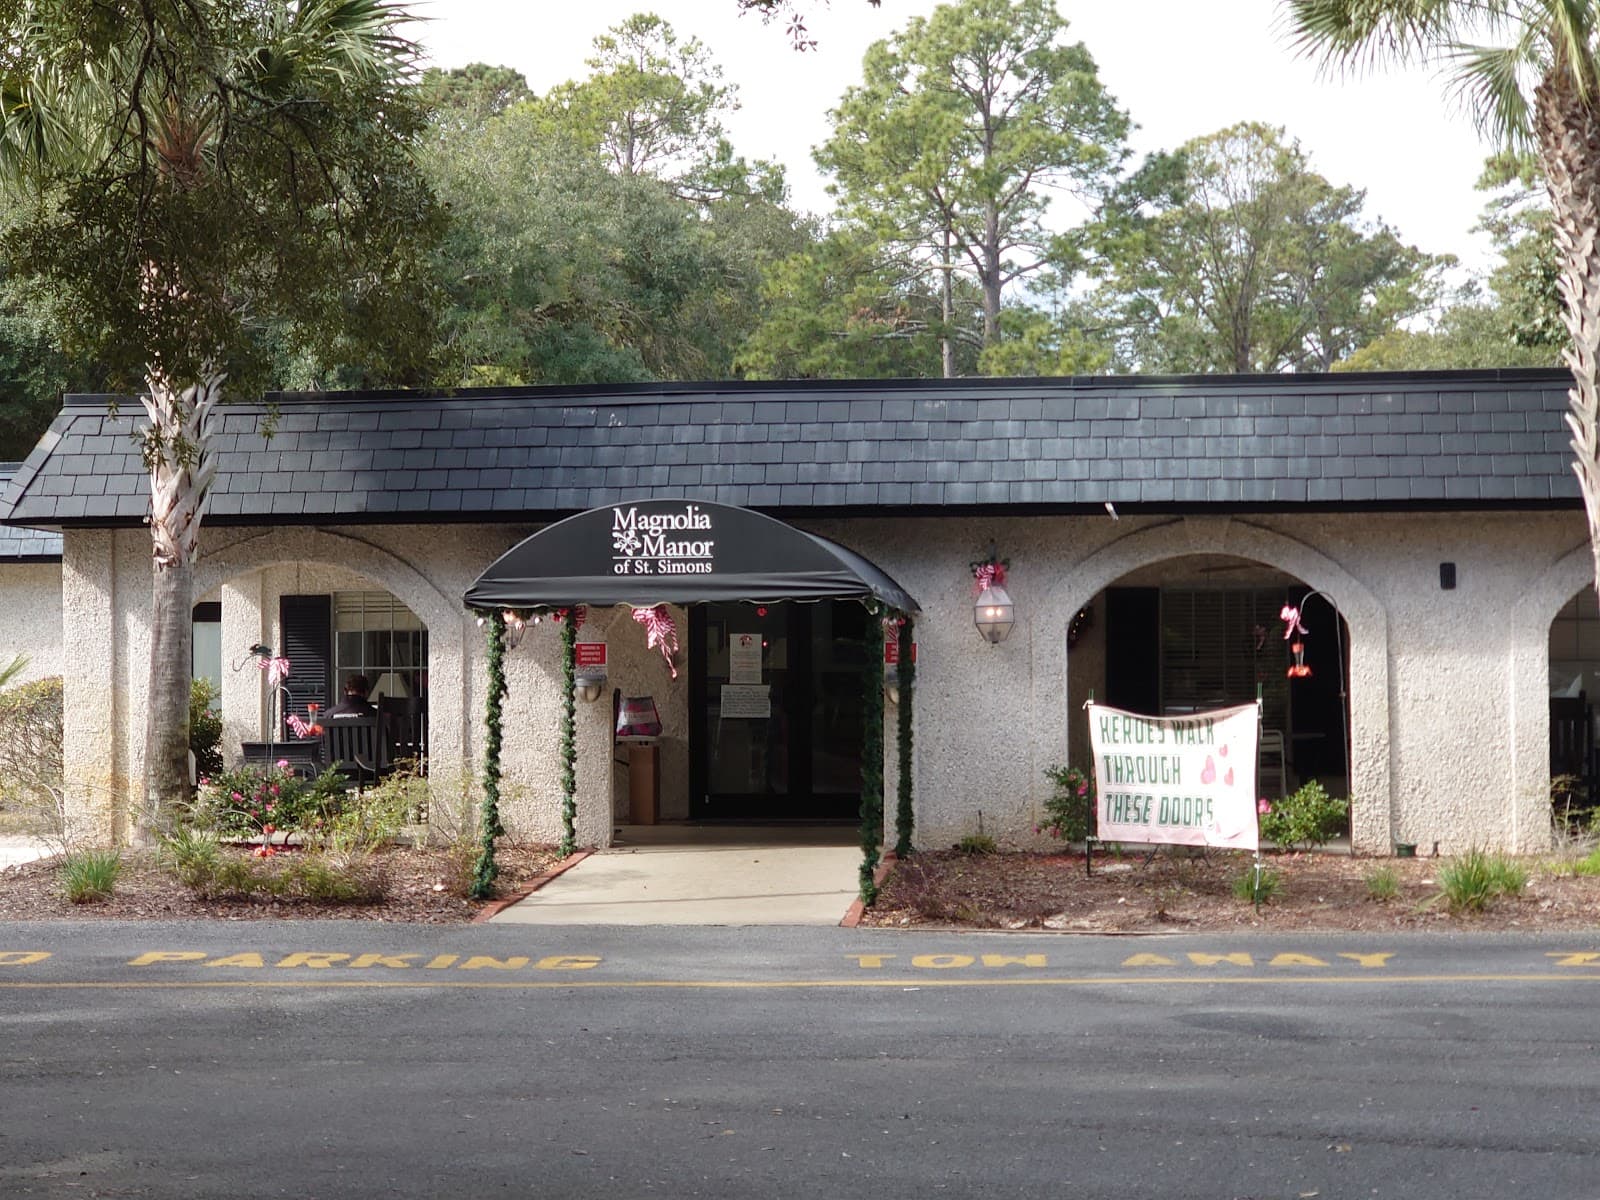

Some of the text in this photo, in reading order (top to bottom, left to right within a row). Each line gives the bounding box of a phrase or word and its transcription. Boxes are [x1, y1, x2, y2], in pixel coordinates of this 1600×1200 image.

[612, 505, 712, 536] Magnolia
[641, 534, 714, 557] Manor
[614, 560, 712, 574] of St. Simons
[1100, 715, 1214, 744] HEROES WALK
[1103, 755, 1181, 785] THROUGH
[1105, 793, 1214, 828] THESE DOORS
[127, 952, 602, 970] PARKING
[845, 954, 1046, 968] TOW
[1120, 953, 1395, 967] AWAY
